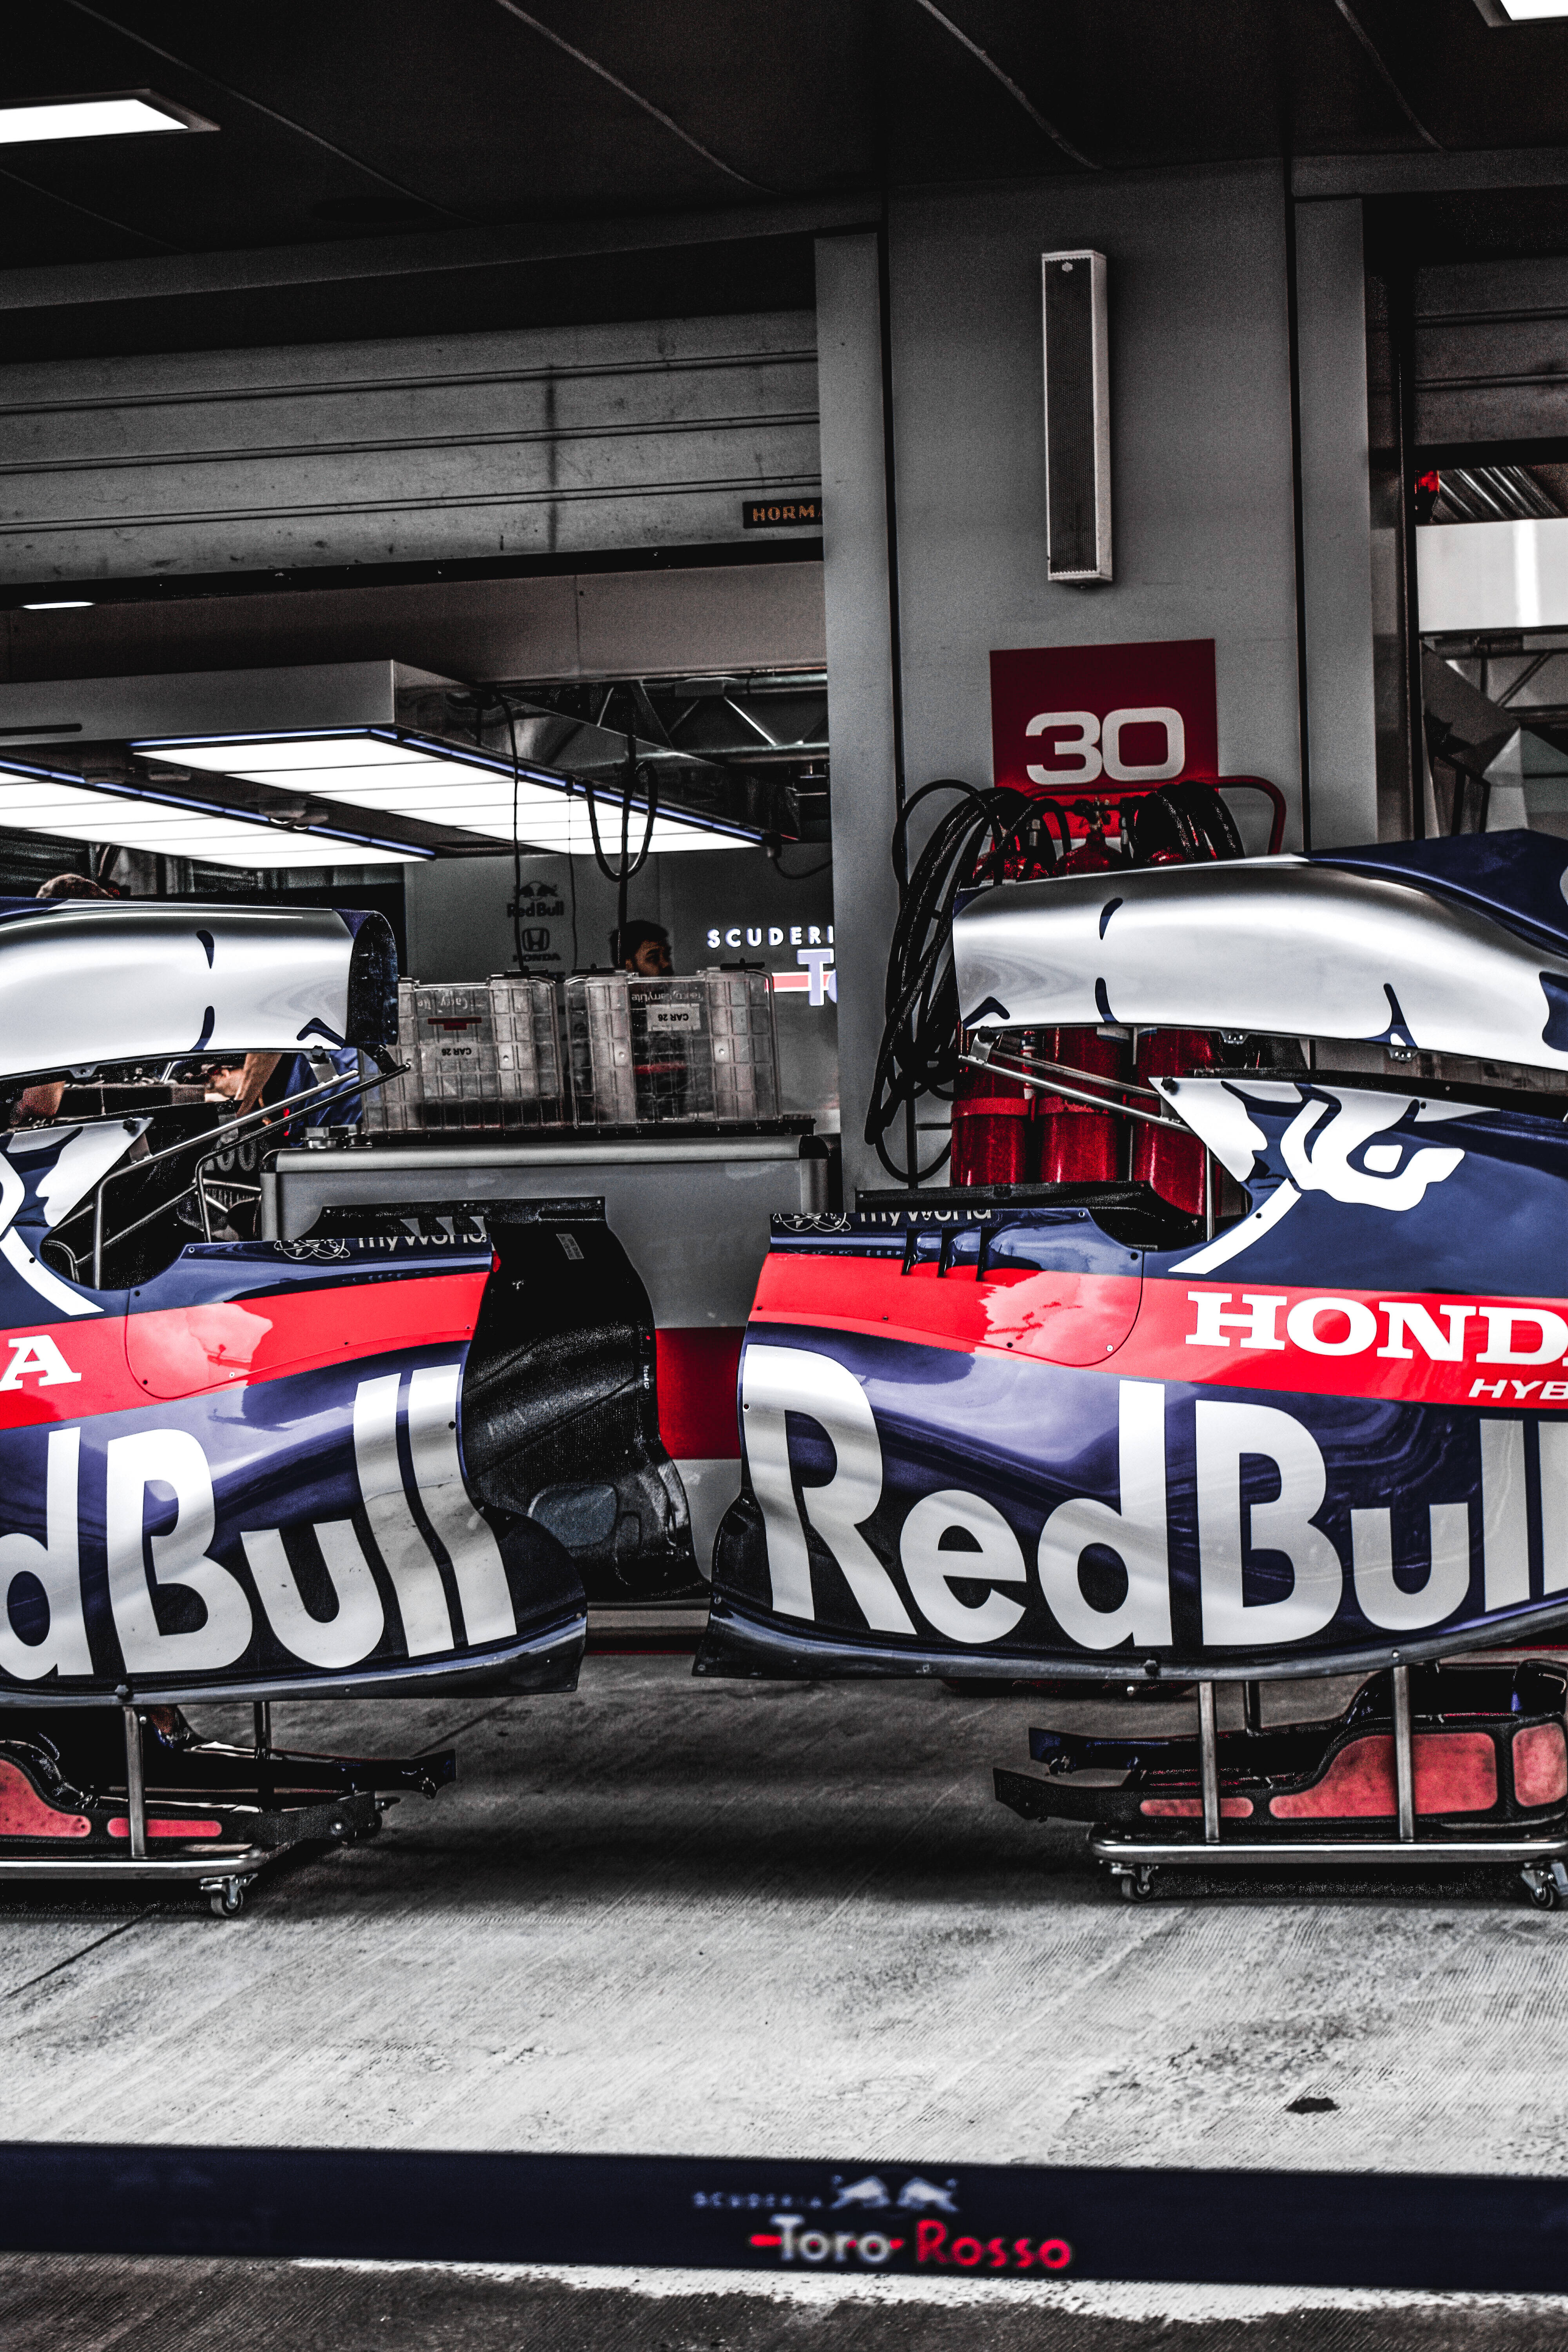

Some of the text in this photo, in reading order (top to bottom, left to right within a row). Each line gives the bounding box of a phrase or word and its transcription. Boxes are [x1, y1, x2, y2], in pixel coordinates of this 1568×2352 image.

[753, 505, 822, 521] HORM
[1025, 706, 1185, 785] 30
[707, 925, 834, 949] SCUDERI
[797, 948, 837, 1006] T
[453, 1047, 472, 1056] CAR
[1185, 1291, 1568, 1368] HOND
[0, 1334, 82, 1392] A
[768, 2213, 1073, 2270] Toro Rosso
